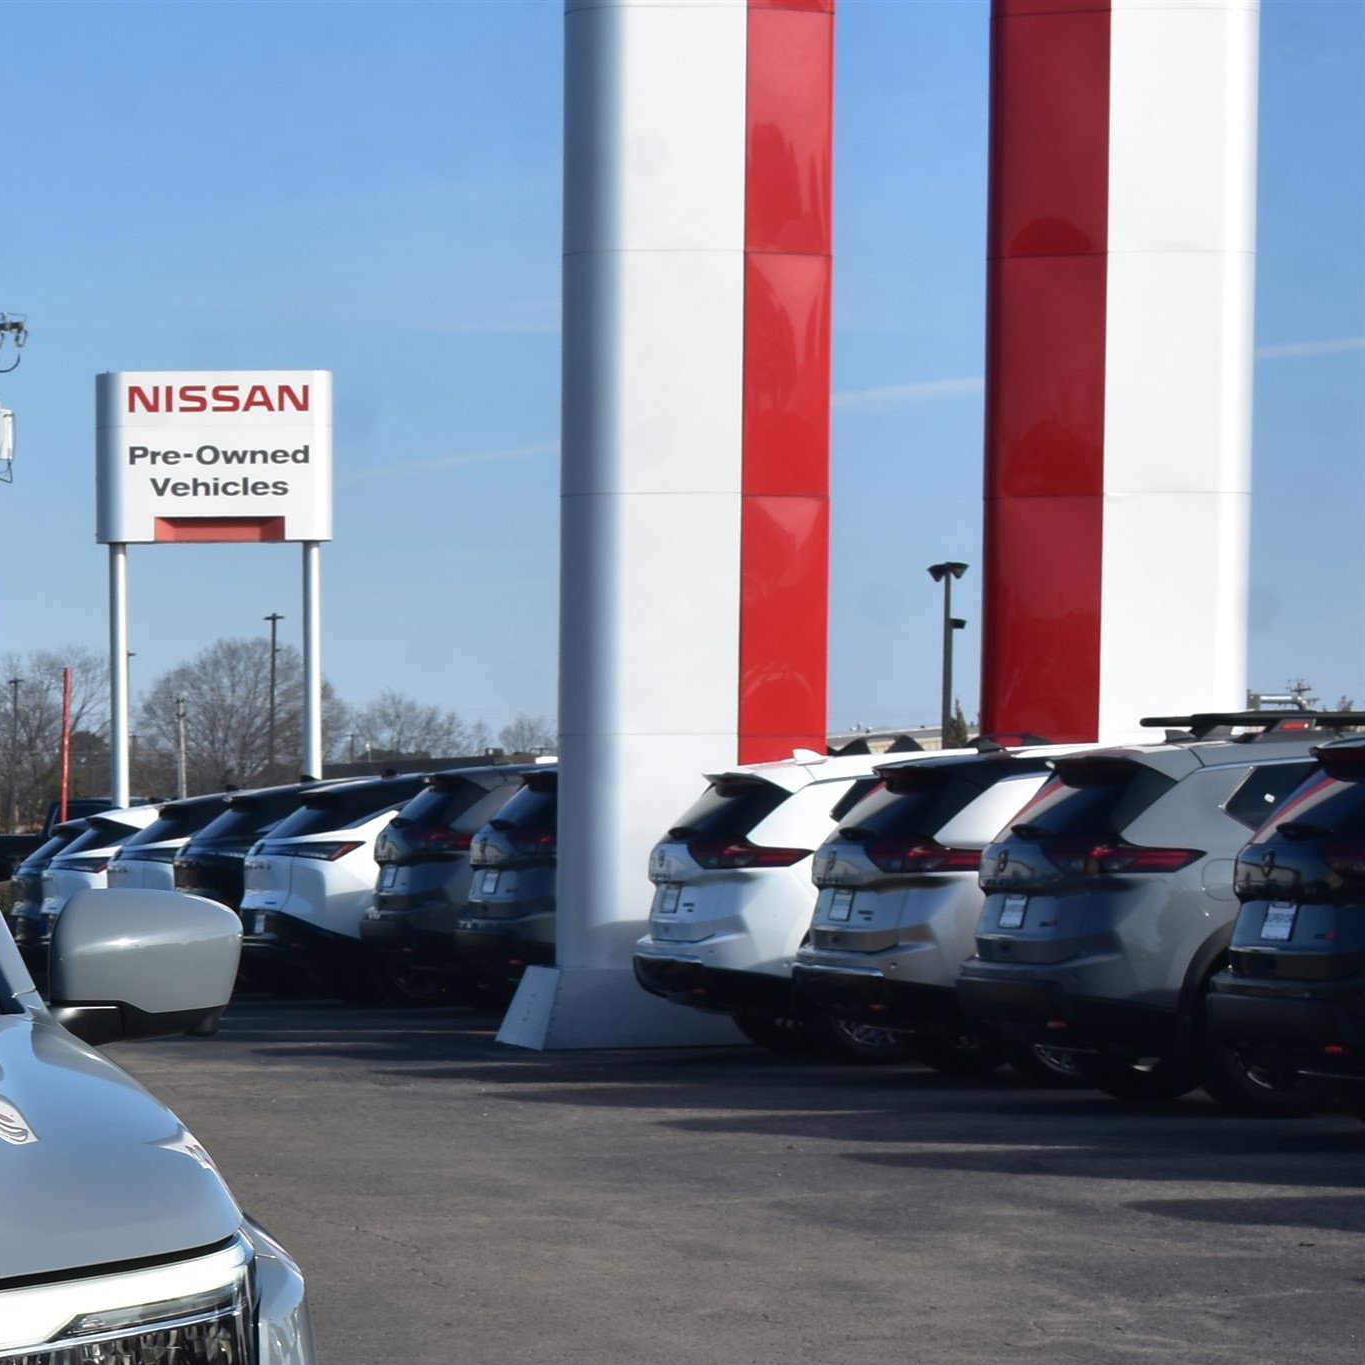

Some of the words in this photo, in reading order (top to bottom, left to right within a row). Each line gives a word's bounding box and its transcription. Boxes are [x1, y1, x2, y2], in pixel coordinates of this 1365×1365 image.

[128, 384, 310, 413] NISSAN
[128, 444, 310, 465] Pre-Owned
[150, 476, 289, 497] Vehicles
